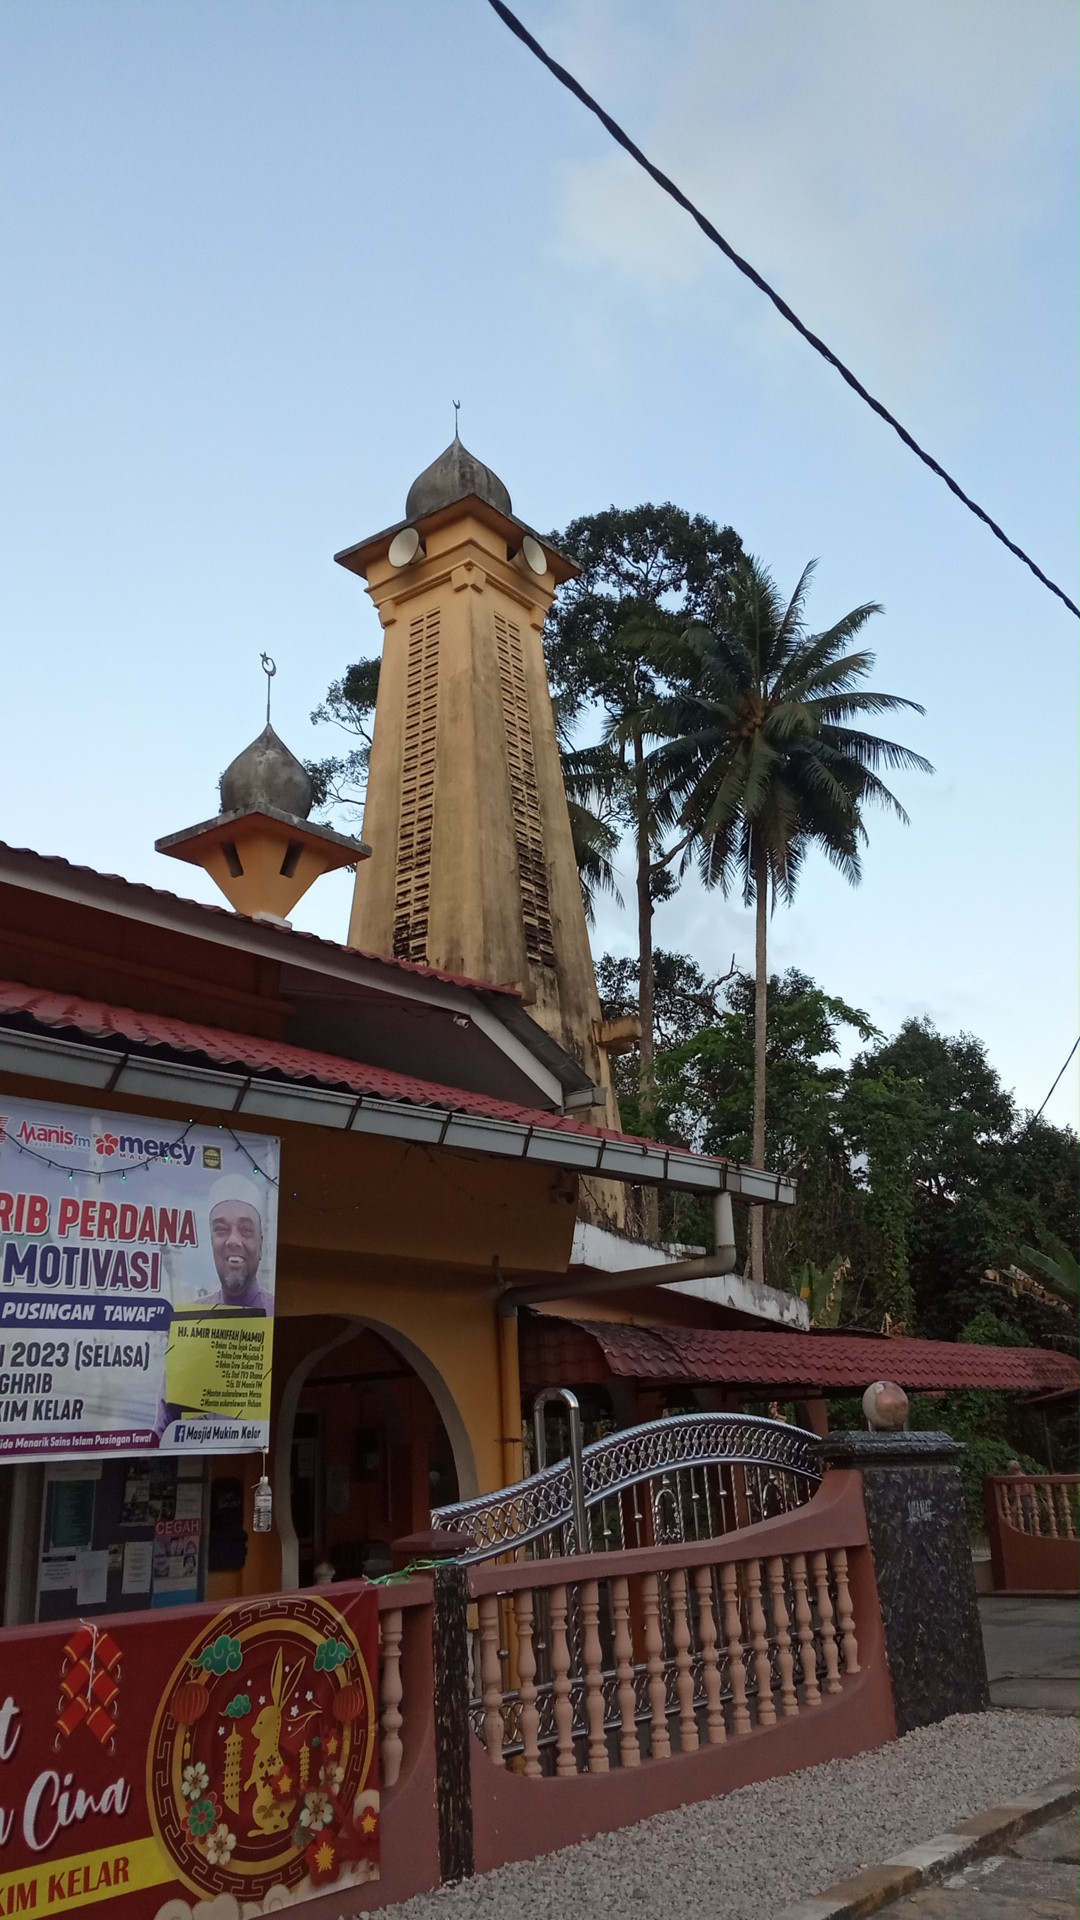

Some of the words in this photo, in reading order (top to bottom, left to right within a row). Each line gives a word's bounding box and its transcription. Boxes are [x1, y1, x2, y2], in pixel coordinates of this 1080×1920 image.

[119, 1135, 196, 1166] mercy
[58, 1198, 197, 1245] PERDANA
[3, 1242, 161, 1290] MOTIVASI
[2, 1302, 96, 1321] PUSINGAN
[178, 1326, 189, 1337] HJ.
[190, 1327, 210, 1338] AMIR
[211, 1328, 240, 1341] HANIFFAH
[239, 1329, 265, 1345] (MAMU)
[10, 1342, 70, 1368] 2023
[75, 1340, 150, 1371] (SELASA)
[32, 1399, 84, 1421] KELAR
[15, 1436, 49, 1448] Menarik
[50, 1436, 70, 1447] Sains
[72, 1436, 93, 1446] Islam
[95, 1434, 131, 1447] Pusingan
[132, 1433, 153, 1443] Tawaf
[186, 1426, 212, 1444] Masjid
[212, 1426, 239, 1440] Mukim
[241, 1426, 261, 1439] Kelar
[155, 1519, 200, 1535] CEGAH
[23, 1770, 130, 1851] Cina
[48, 1856, 130, 1904] KELAR
